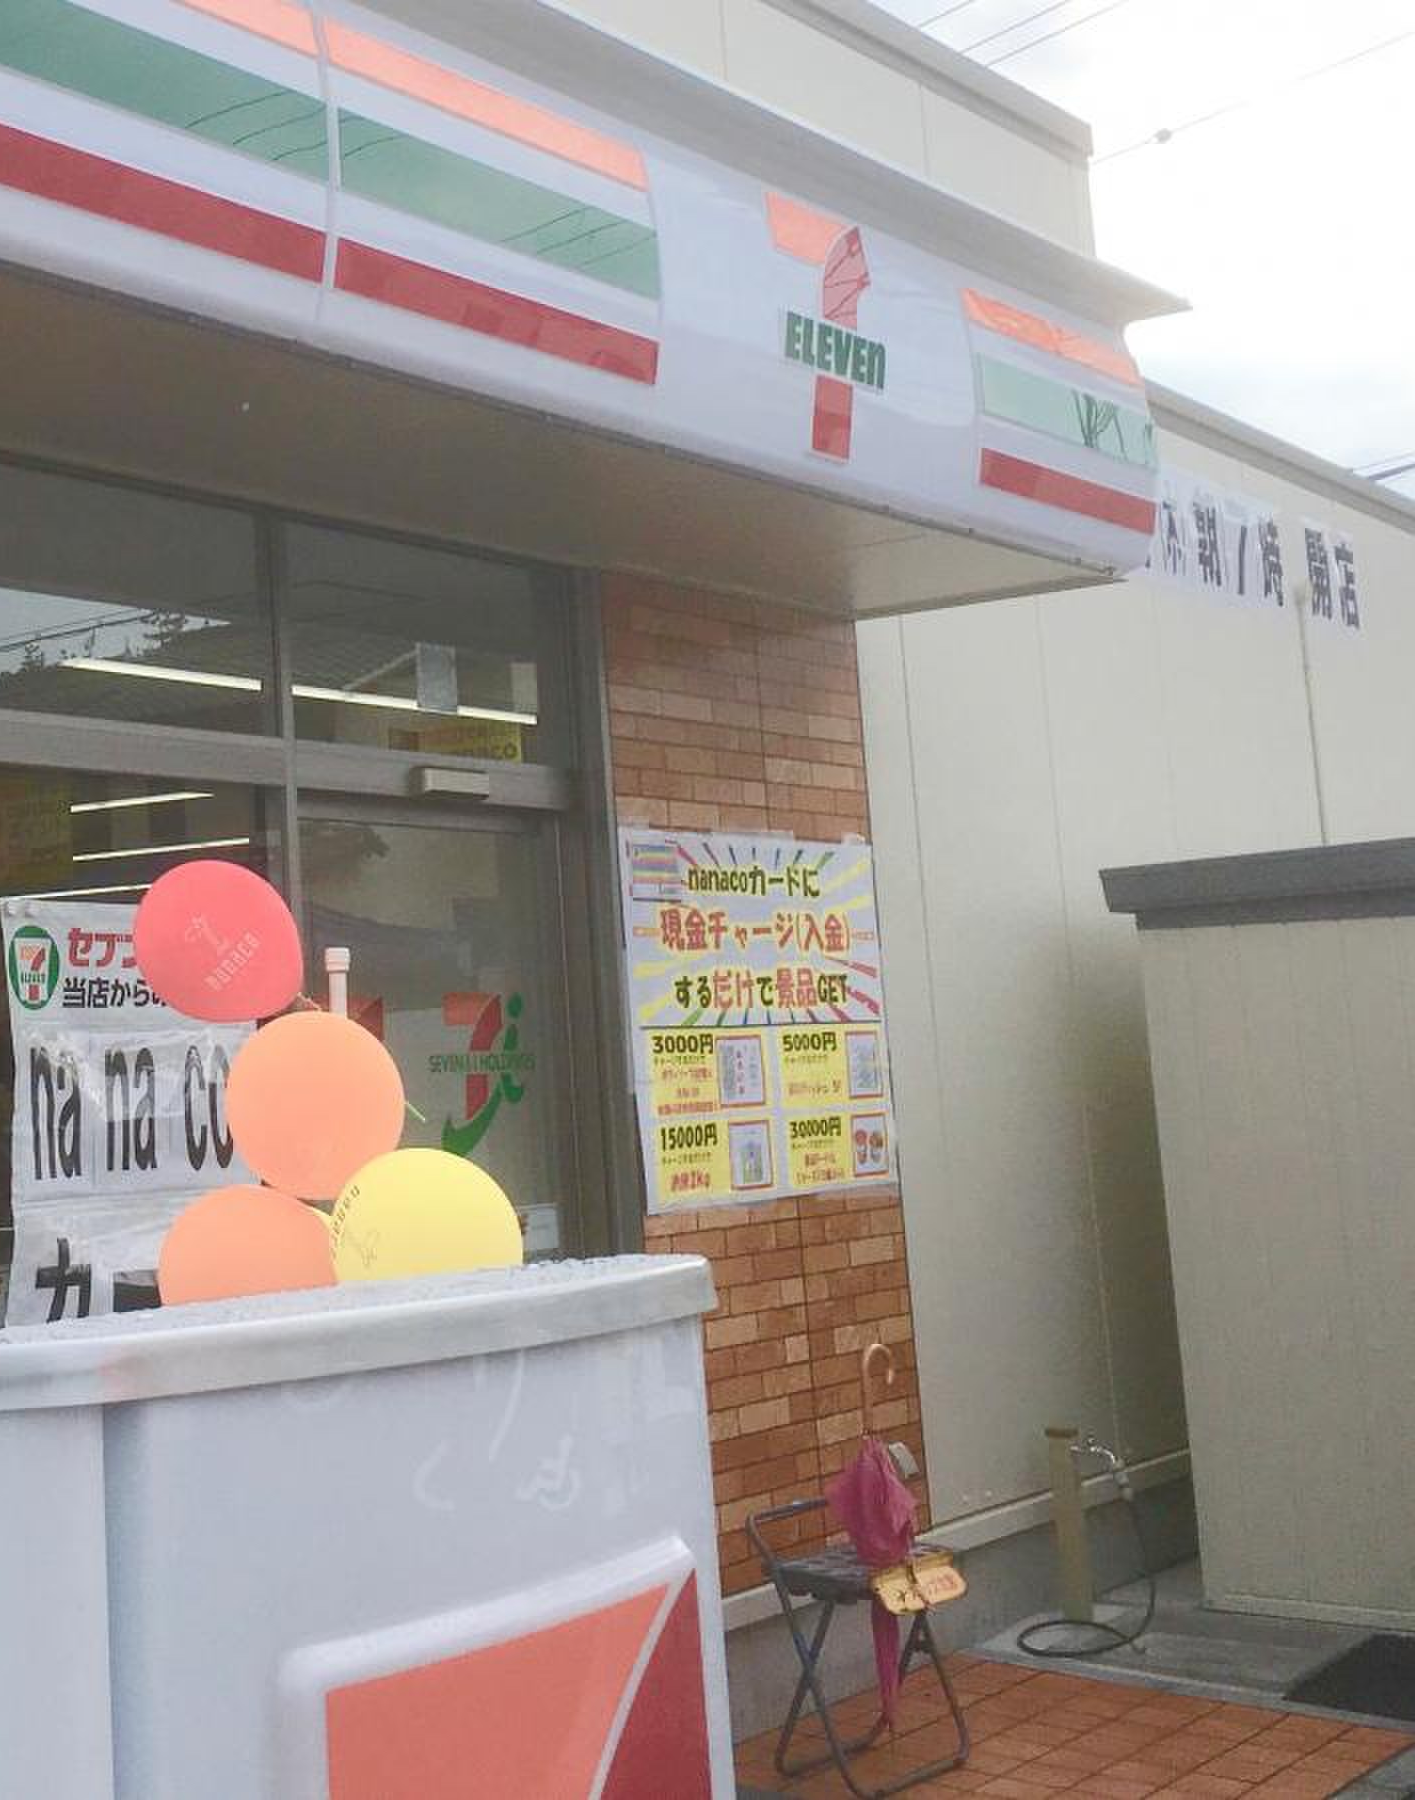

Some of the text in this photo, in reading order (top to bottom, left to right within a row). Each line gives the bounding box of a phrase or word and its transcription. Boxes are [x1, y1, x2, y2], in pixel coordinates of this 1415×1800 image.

[660, 908, 850, 952] 現金チャージ(入金)
[652, 1033, 714, 1055] 3000円
[782, 1031, 838, 1053] 5000円
[661, 1122, 718, 1153] 15000円
